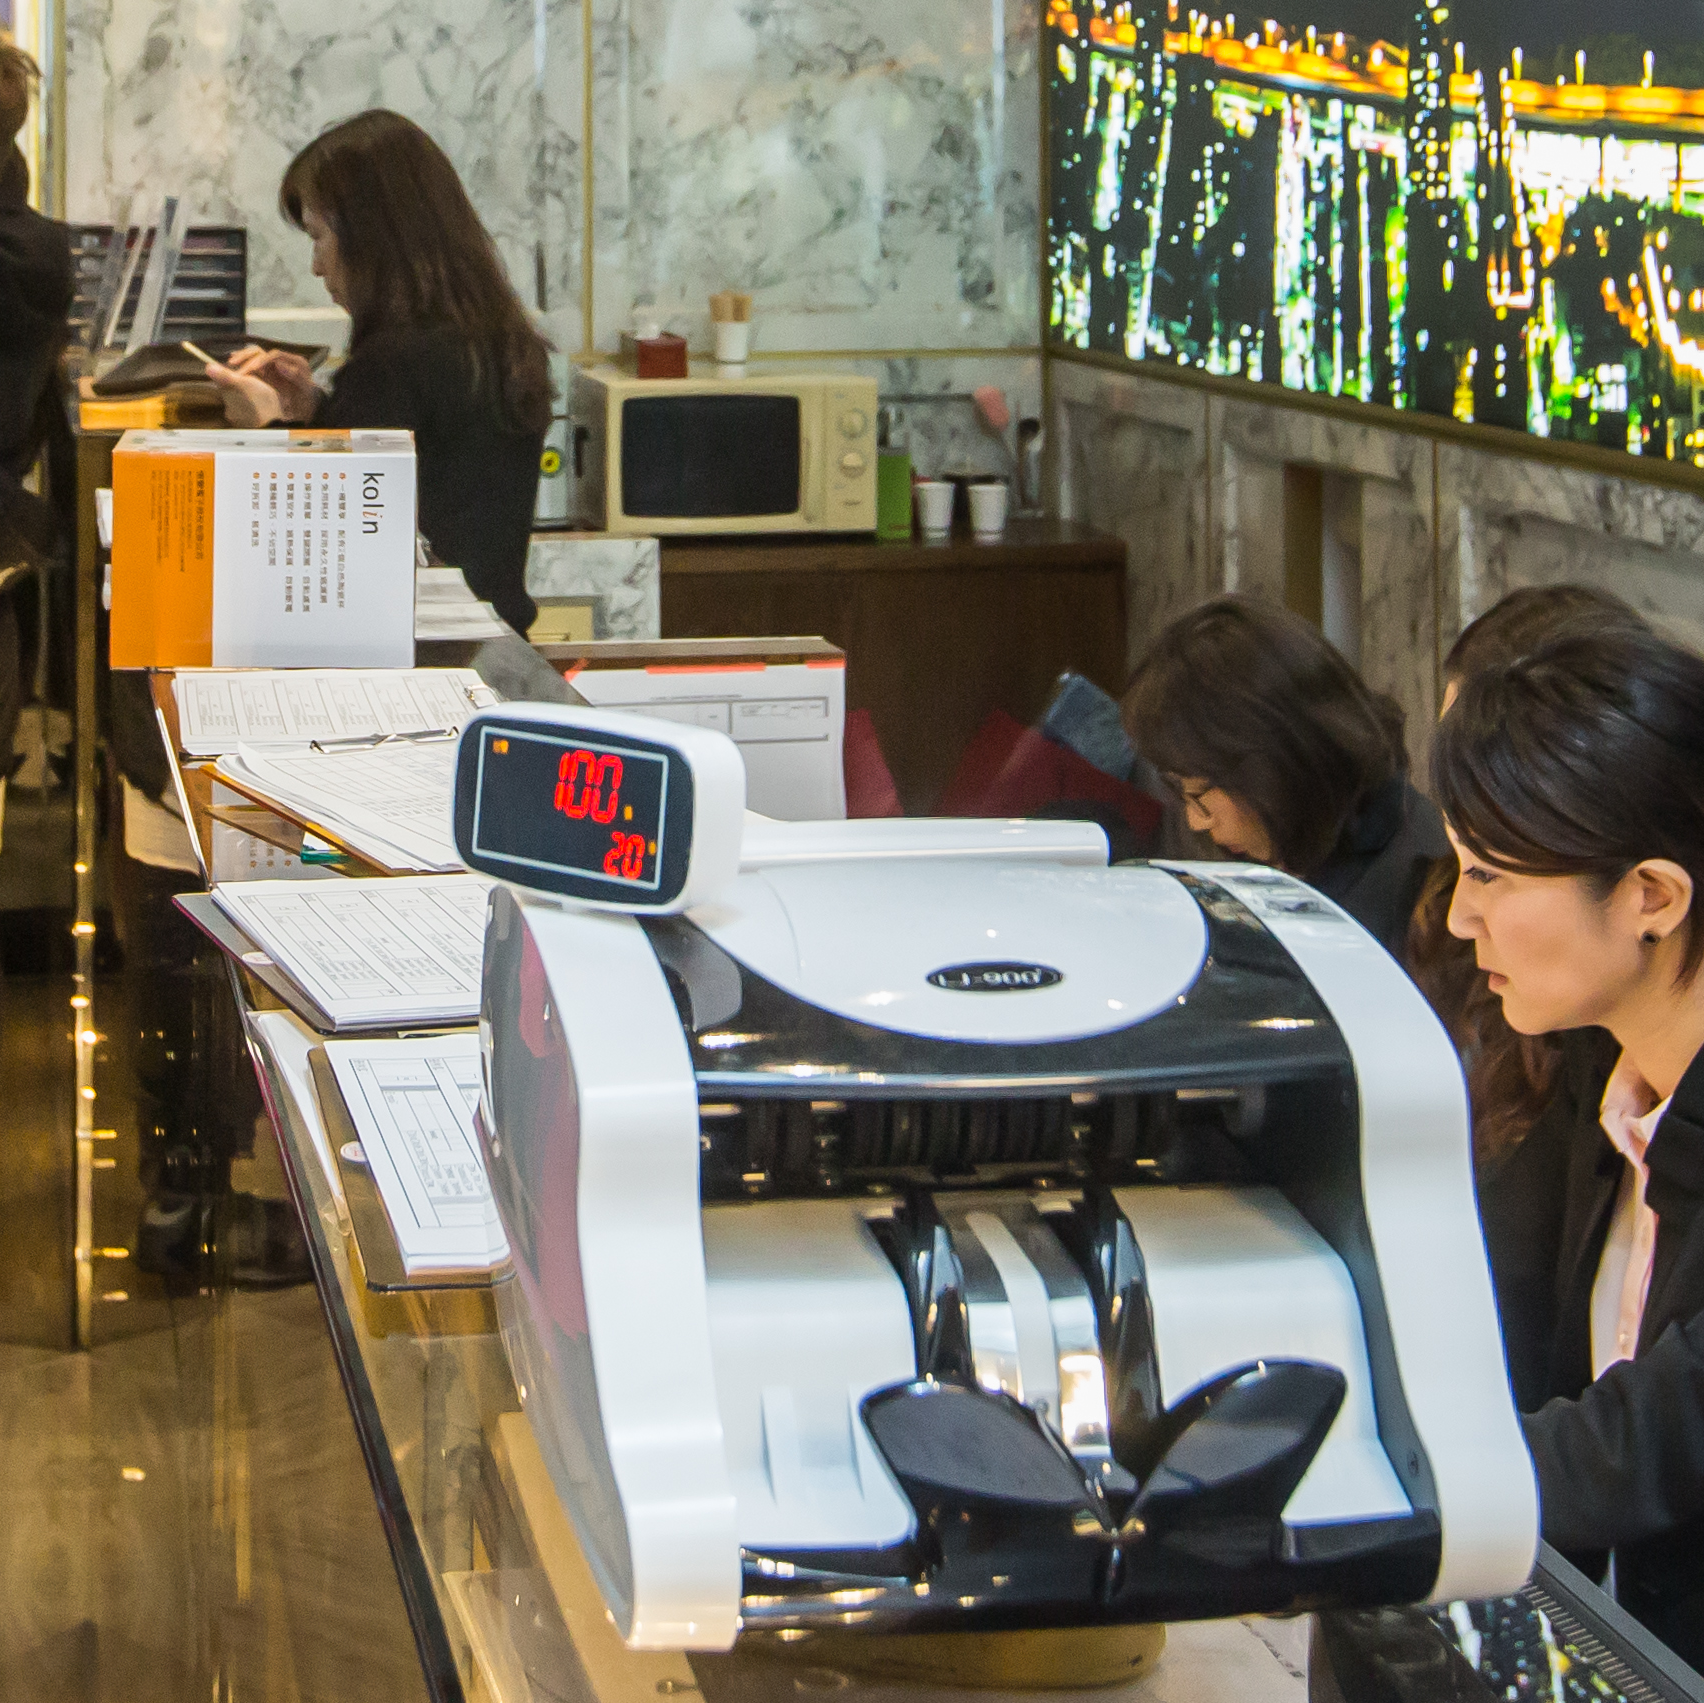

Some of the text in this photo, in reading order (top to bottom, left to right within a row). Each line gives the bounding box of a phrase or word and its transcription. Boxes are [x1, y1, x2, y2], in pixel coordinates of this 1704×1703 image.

[362, 472, 385, 535] kolin
[554, 749, 624, 824] 100
[603, 831, 646, 881] 20
